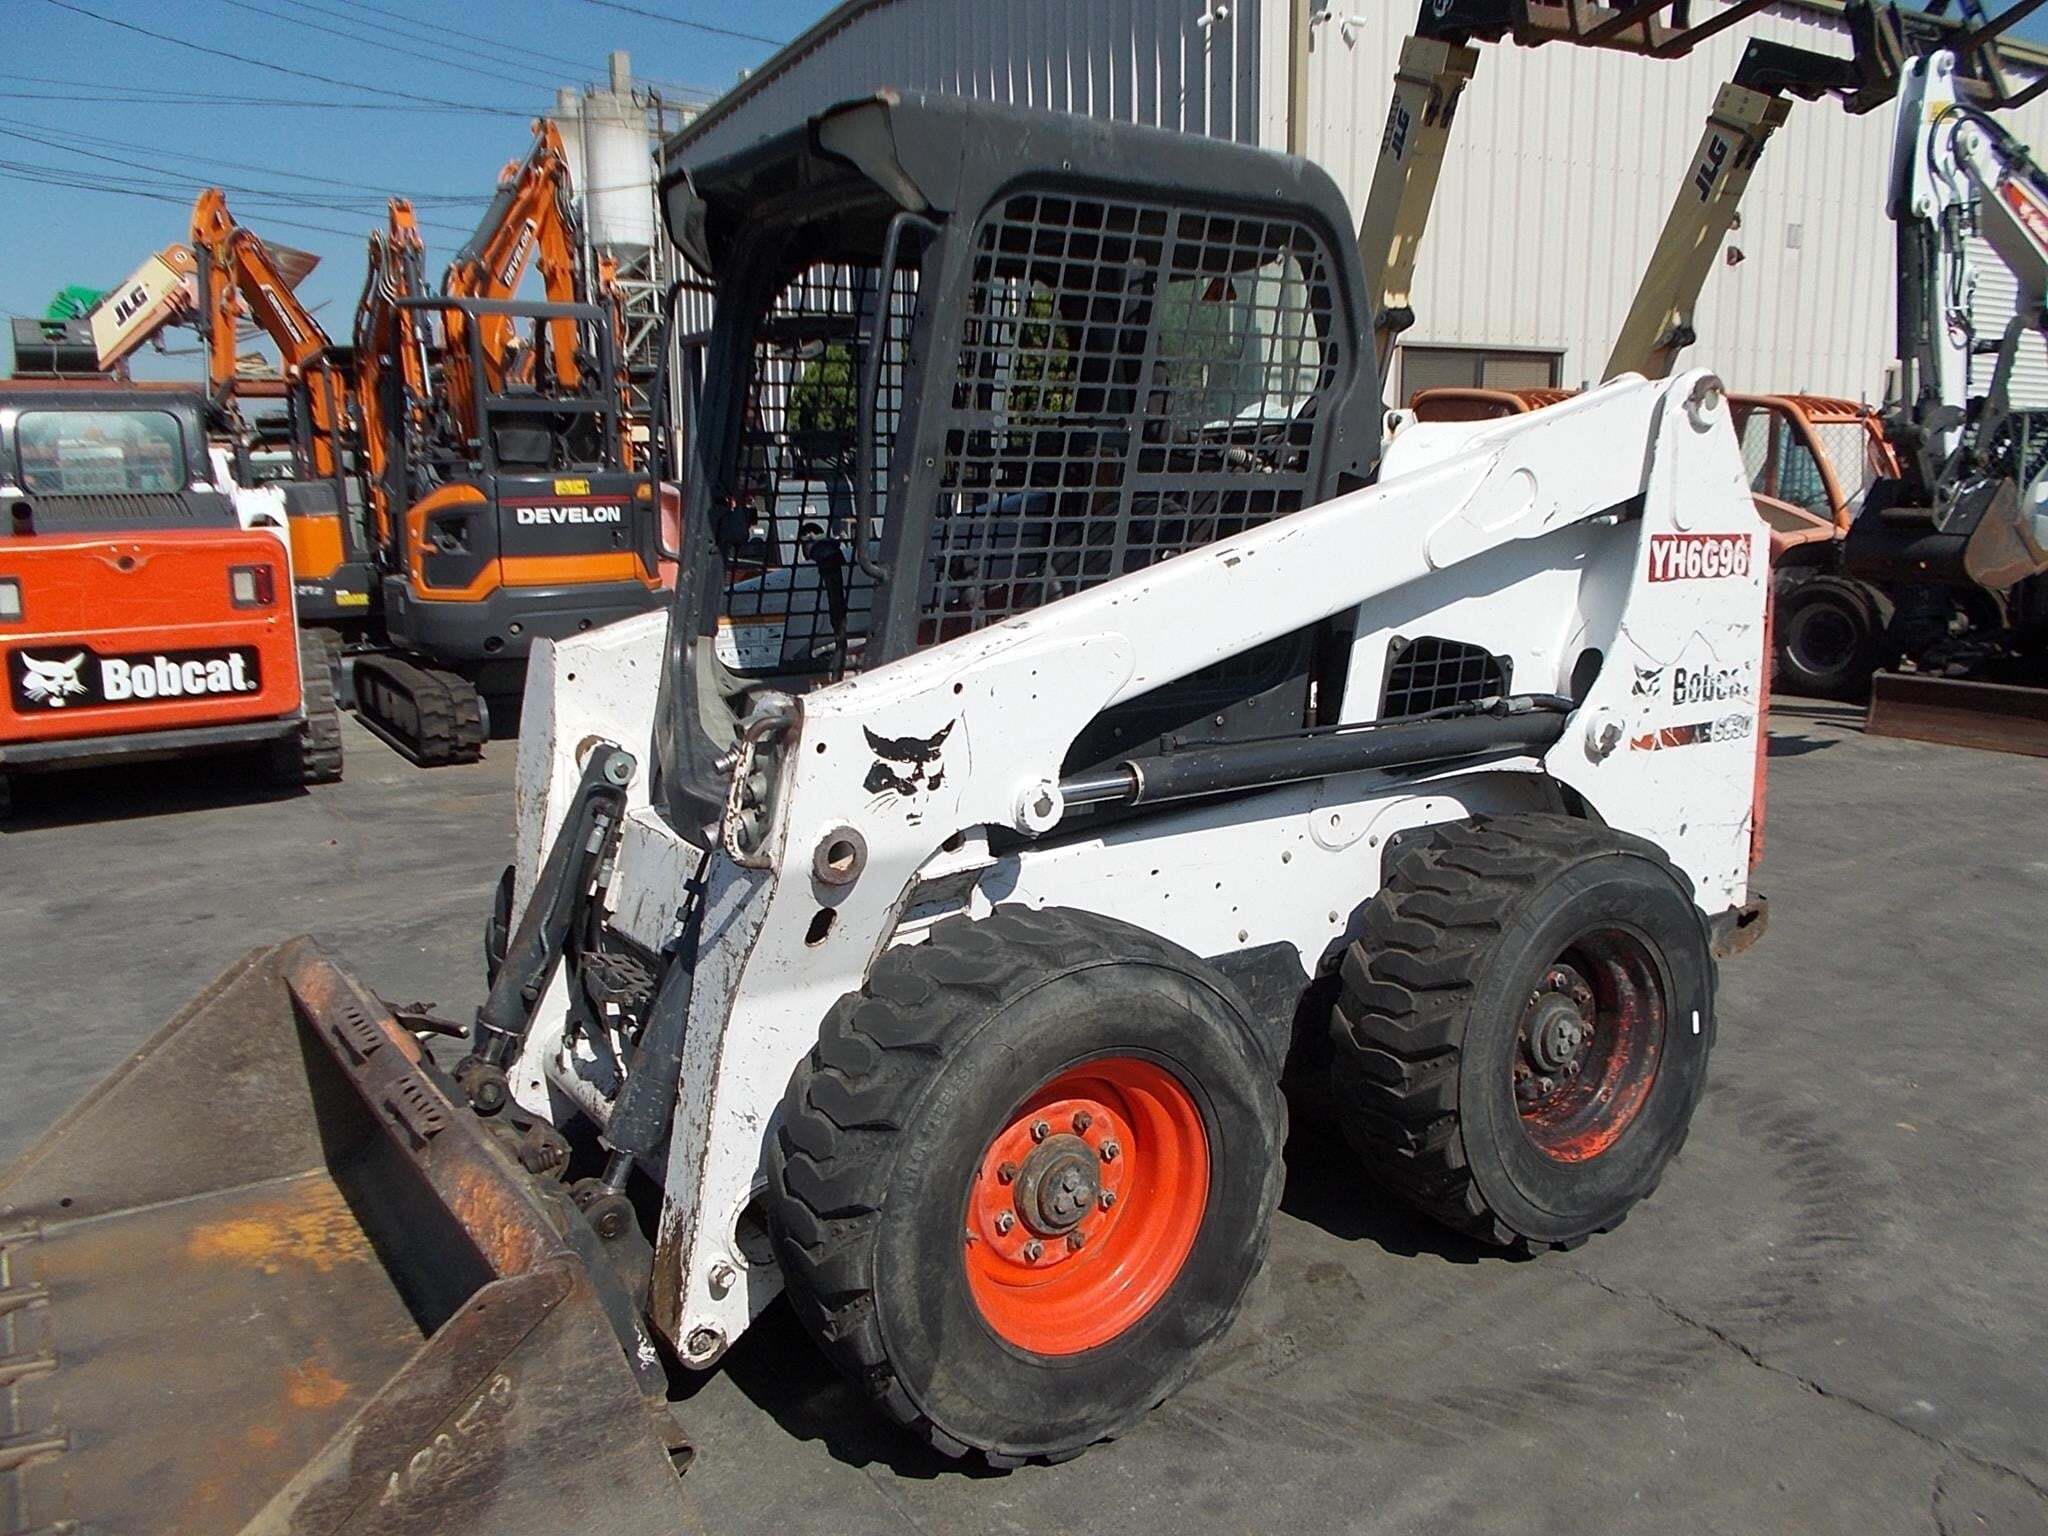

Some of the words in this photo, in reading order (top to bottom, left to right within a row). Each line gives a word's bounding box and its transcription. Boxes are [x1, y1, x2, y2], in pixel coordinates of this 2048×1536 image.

[1392, 107, 1410, 160] JLG
[1694, 134, 1728, 203] JLG
[115, 285, 148, 327] JLG
[516, 506, 621, 525] DEVELON
[1652, 539, 1748, 578] YH6G96
[100, 652, 248, 700] Bobcat
